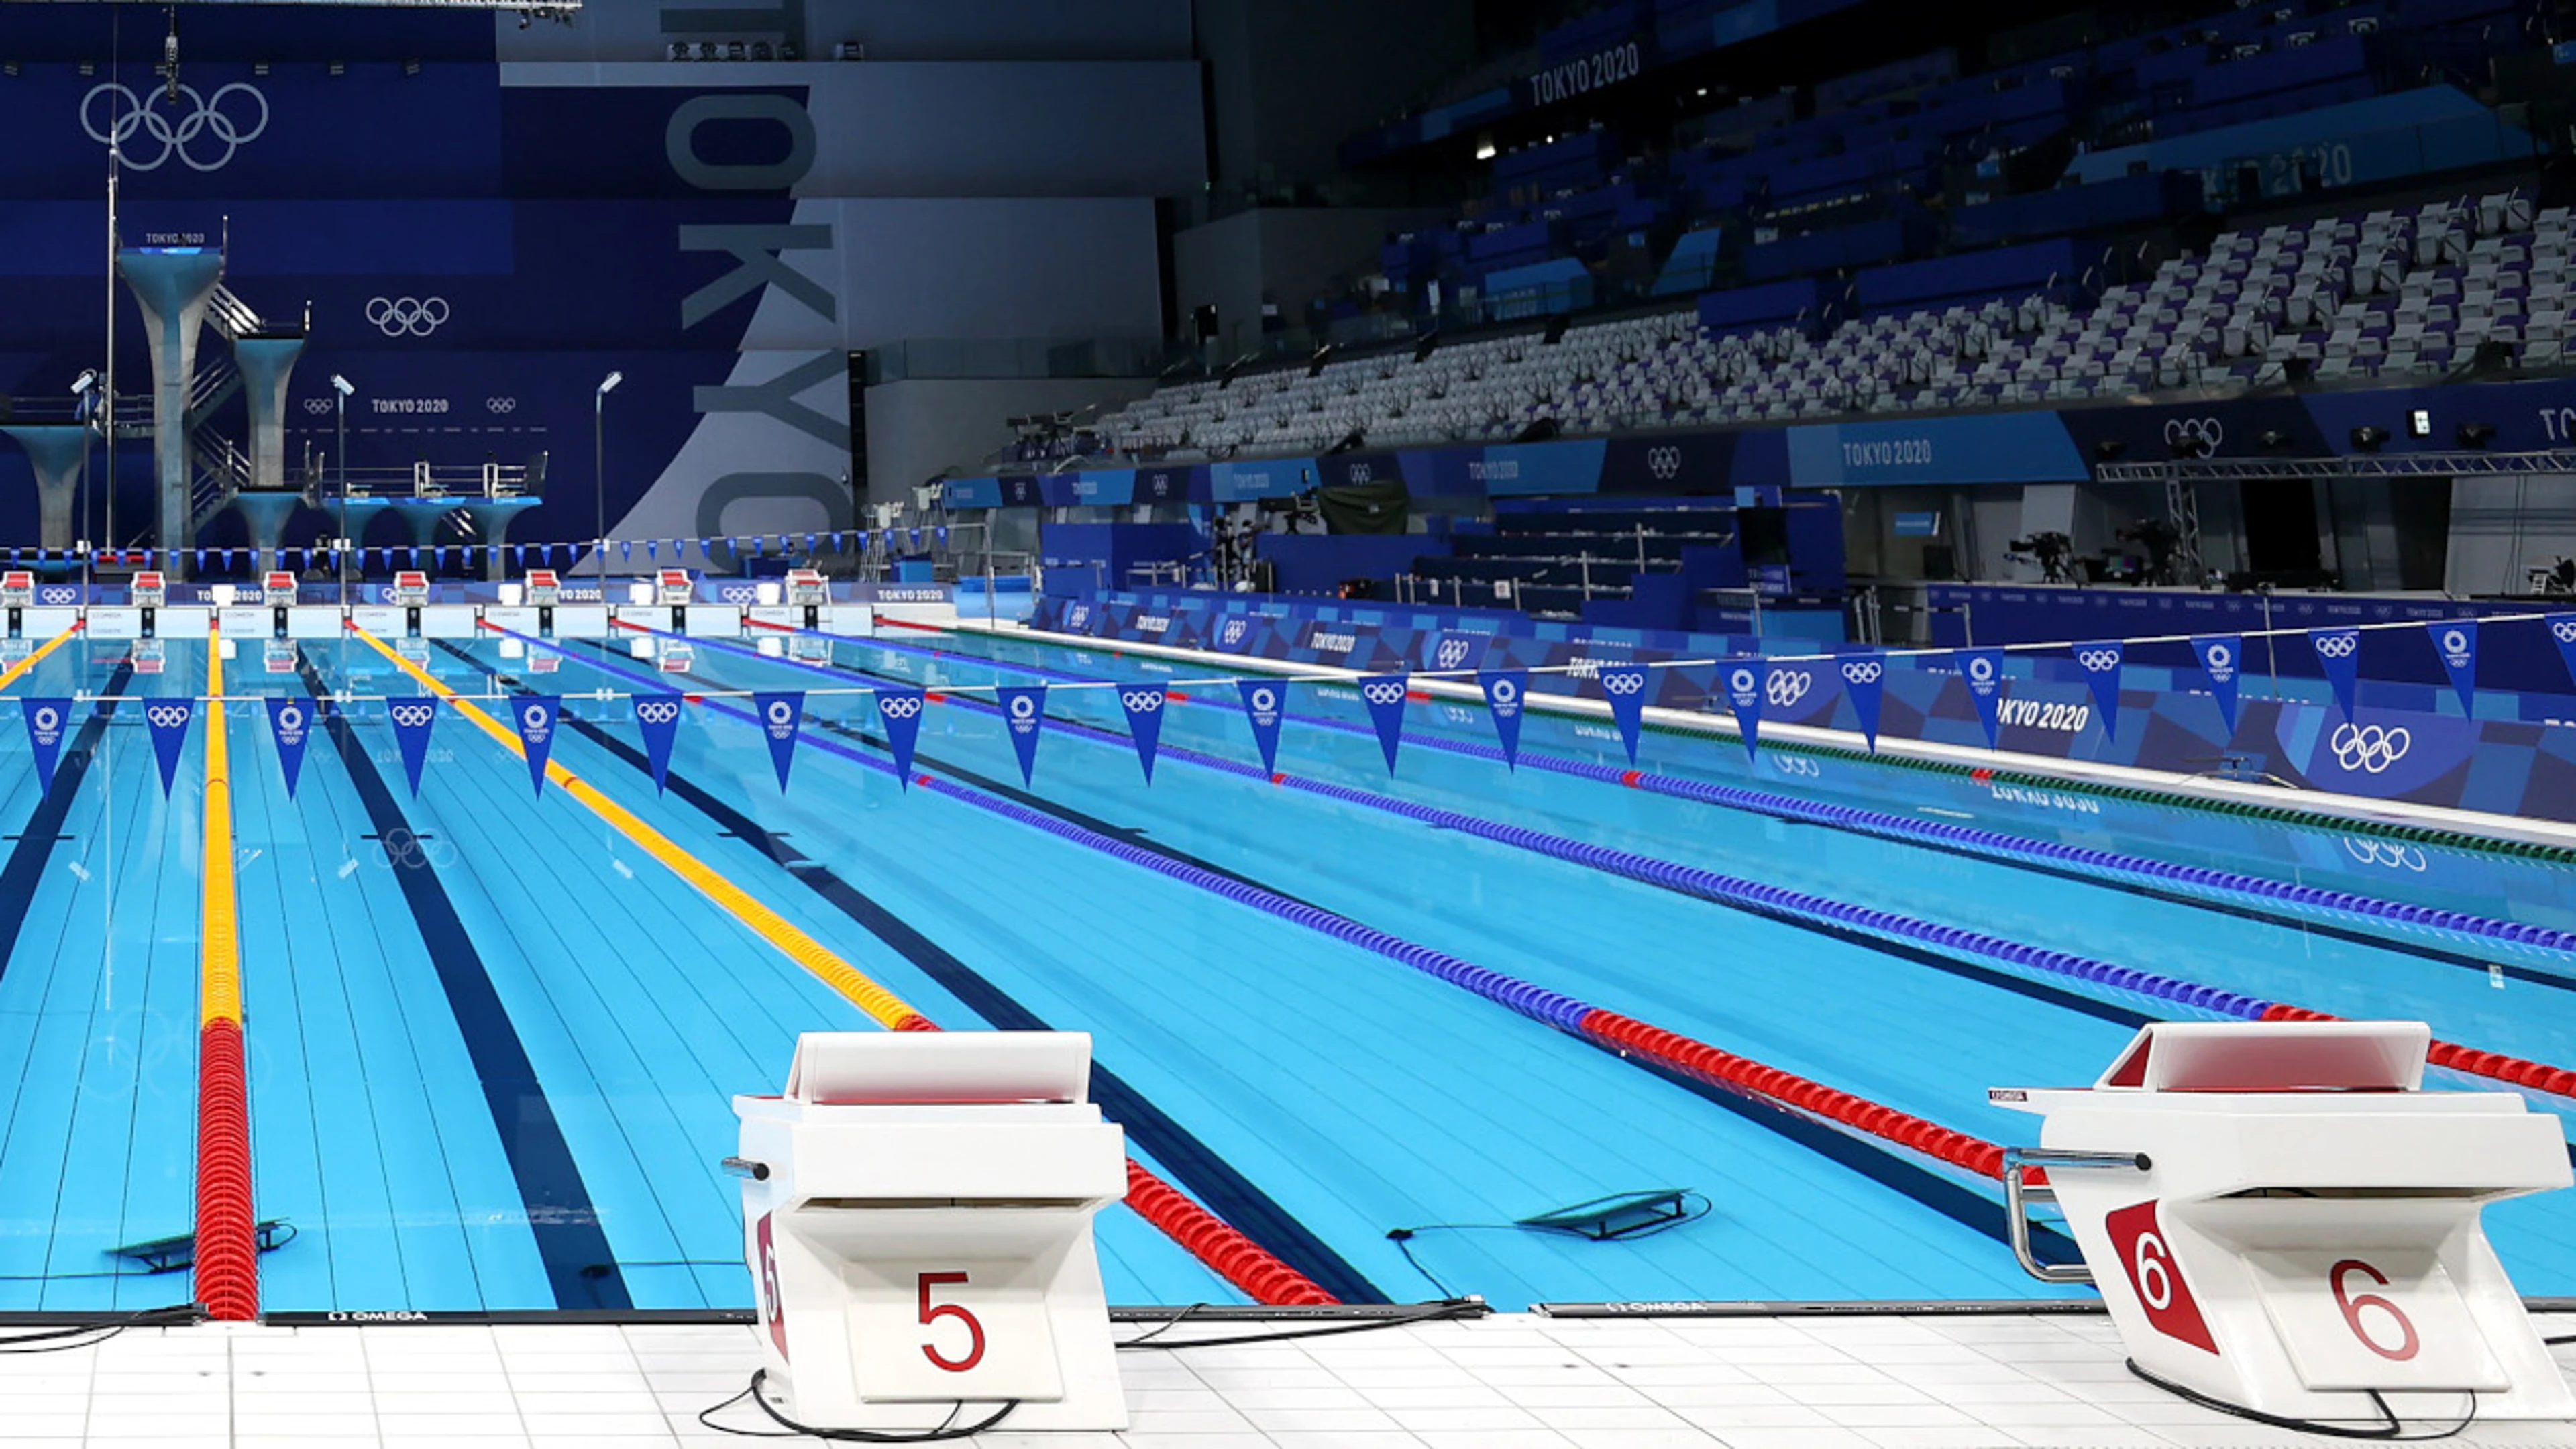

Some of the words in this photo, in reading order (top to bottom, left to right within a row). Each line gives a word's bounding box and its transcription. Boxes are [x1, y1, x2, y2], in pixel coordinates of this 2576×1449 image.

[1530, 59, 1589, 107] TOKYO
[1591, 42, 1639, 88] 2020
[145, 233, 178, 244] TOKYO
[370, 398, 414, 412] TOKYO
[415, 398, 449, 413] 2020
[1843, 441, 1892, 466] TOKYO
[1894, 439, 1933, 465] 2020
[575, 590, 601, 600] 2020
[877, 590, 915, 600] TOKYO
[916, 590, 943, 600] 2020
[1311, 633, 1338, 650] TOKYO
[1996, 697, 2040, 727] KYO
[2037, 702, 2089, 732] 2020
[764, 1243, 780, 1322] 5
[2135, 1232, 2171, 1311] 6
[352, 1311, 428, 1322] OMEGA
[1627, 1302, 1705, 1313] OMEGA
[2330, 1259, 2420, 1362] 6
[918, 1271, 985, 1372] 5
